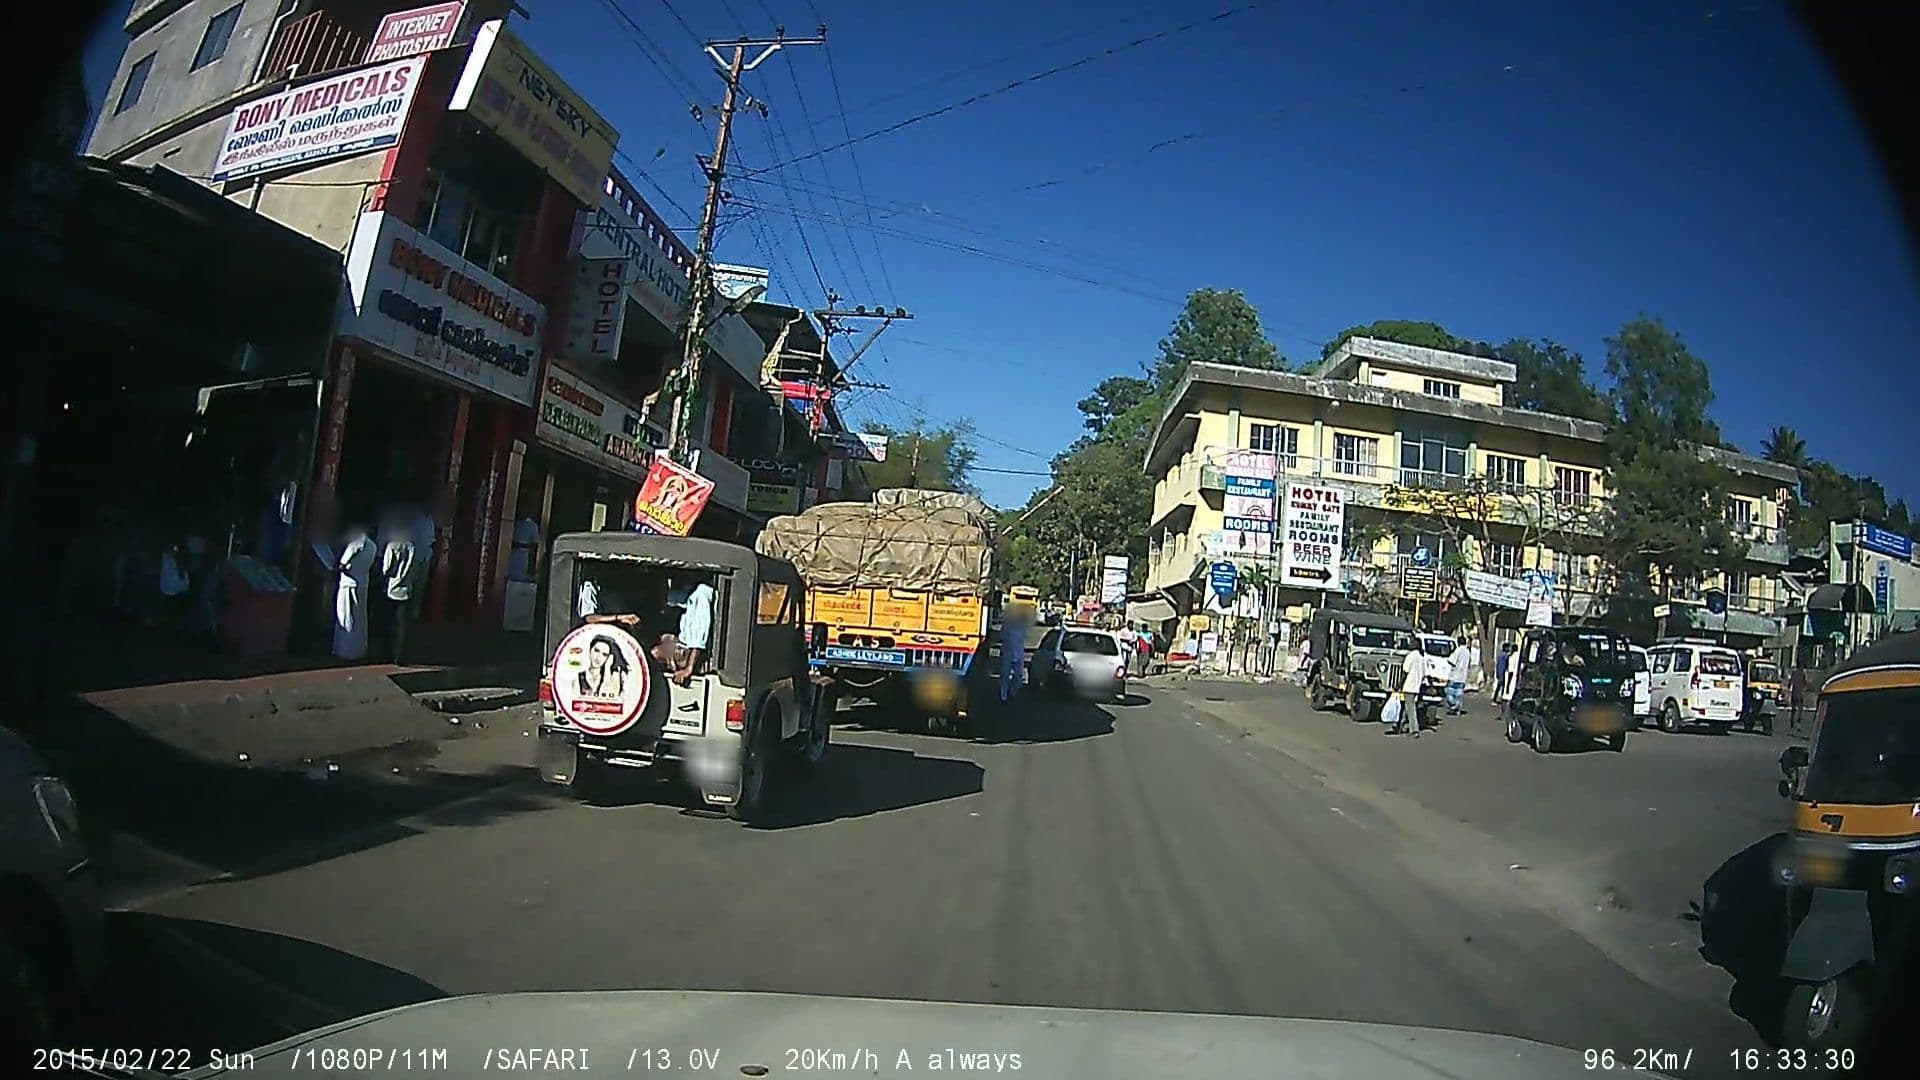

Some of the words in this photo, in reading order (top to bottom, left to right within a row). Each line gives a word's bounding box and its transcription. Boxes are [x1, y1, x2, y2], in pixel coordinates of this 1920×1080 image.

[386, 12, 448, 40] INTERNET
[372, 33, 448, 61] PHOTOSTAT
[234, 96, 288, 133] BONY
[290, 66, 411, 119] MEDICALS
[519, 66, 593, 139] NETSKY
[595, 208, 655, 282] CENTRAL
[592, 263, 622, 354] HOTEL
[1292, 486, 1340, 504] HOTEL
[1225, 518, 1269, 532] ROOMS
[1288, 530, 1339, 544] ROOMS
[1293, 542, 1332, 558] BEER
